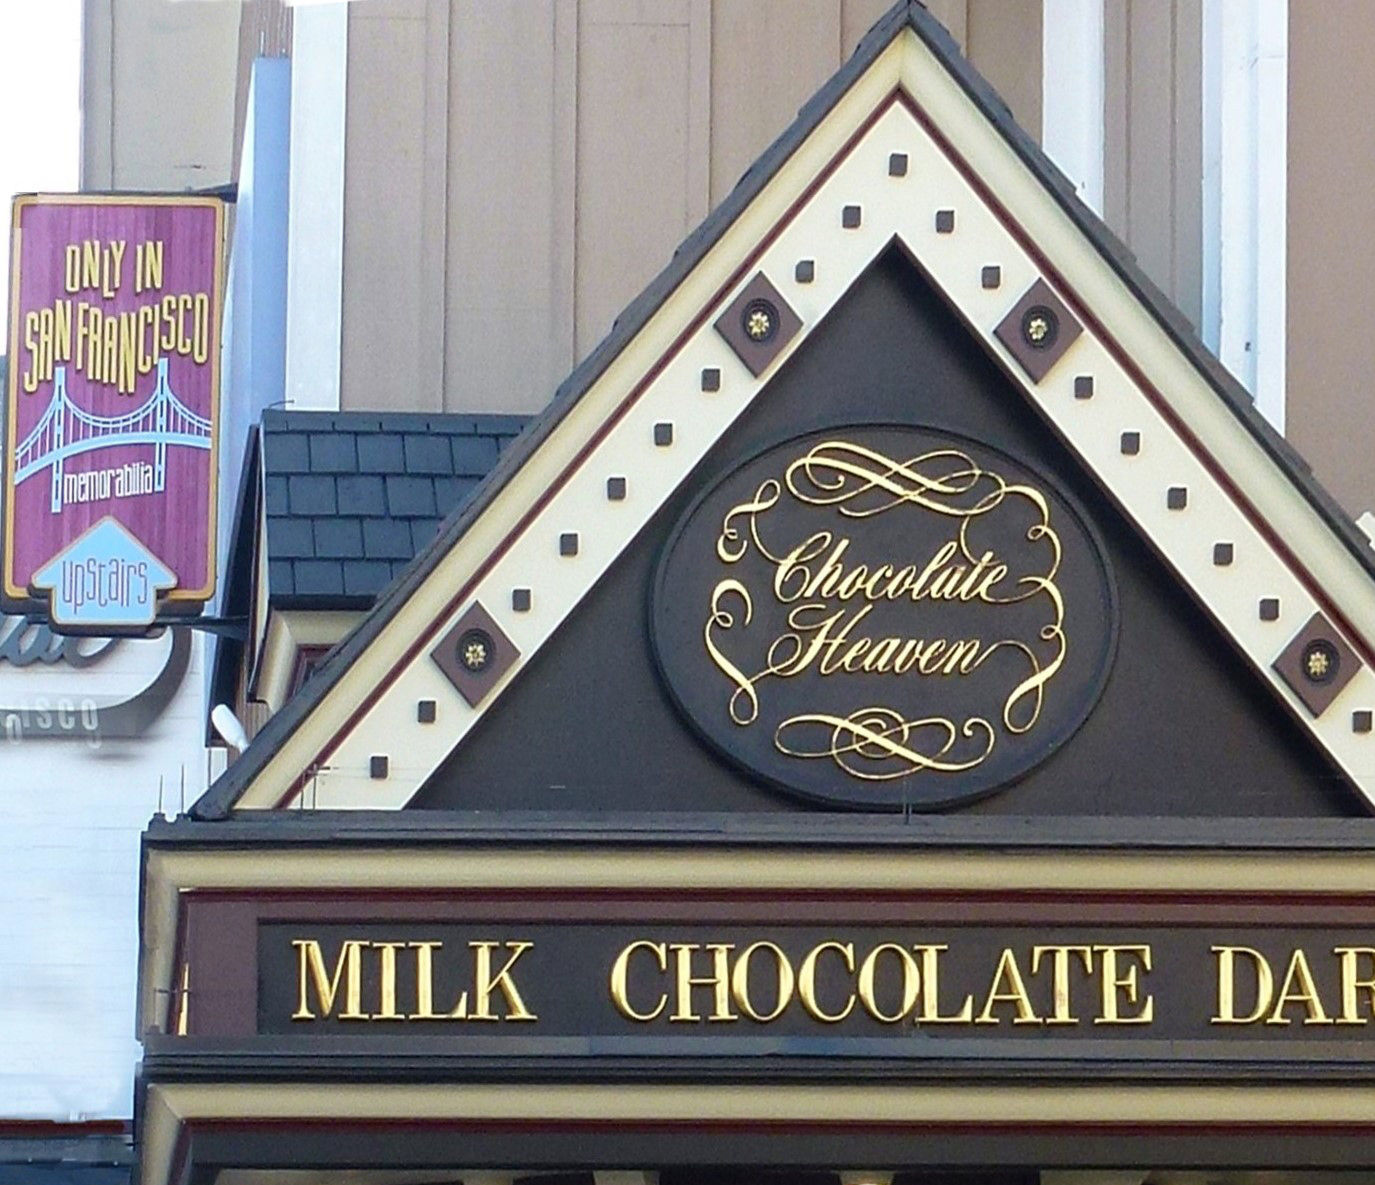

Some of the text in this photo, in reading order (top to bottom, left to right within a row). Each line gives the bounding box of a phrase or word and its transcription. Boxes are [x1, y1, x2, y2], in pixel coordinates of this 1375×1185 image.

[65, 239, 164, 299] ONLY IN
[23, 293, 209, 395] SAN FRANCISCO
[63, 461, 153, 505] memorabilia
[773, 531, 1010, 602] Chocolate
[768, 604, 981, 677] Heaven
[291, 940, 537, 1020] MILK
[610, 940, 1154, 1024] CHOCOLATE
